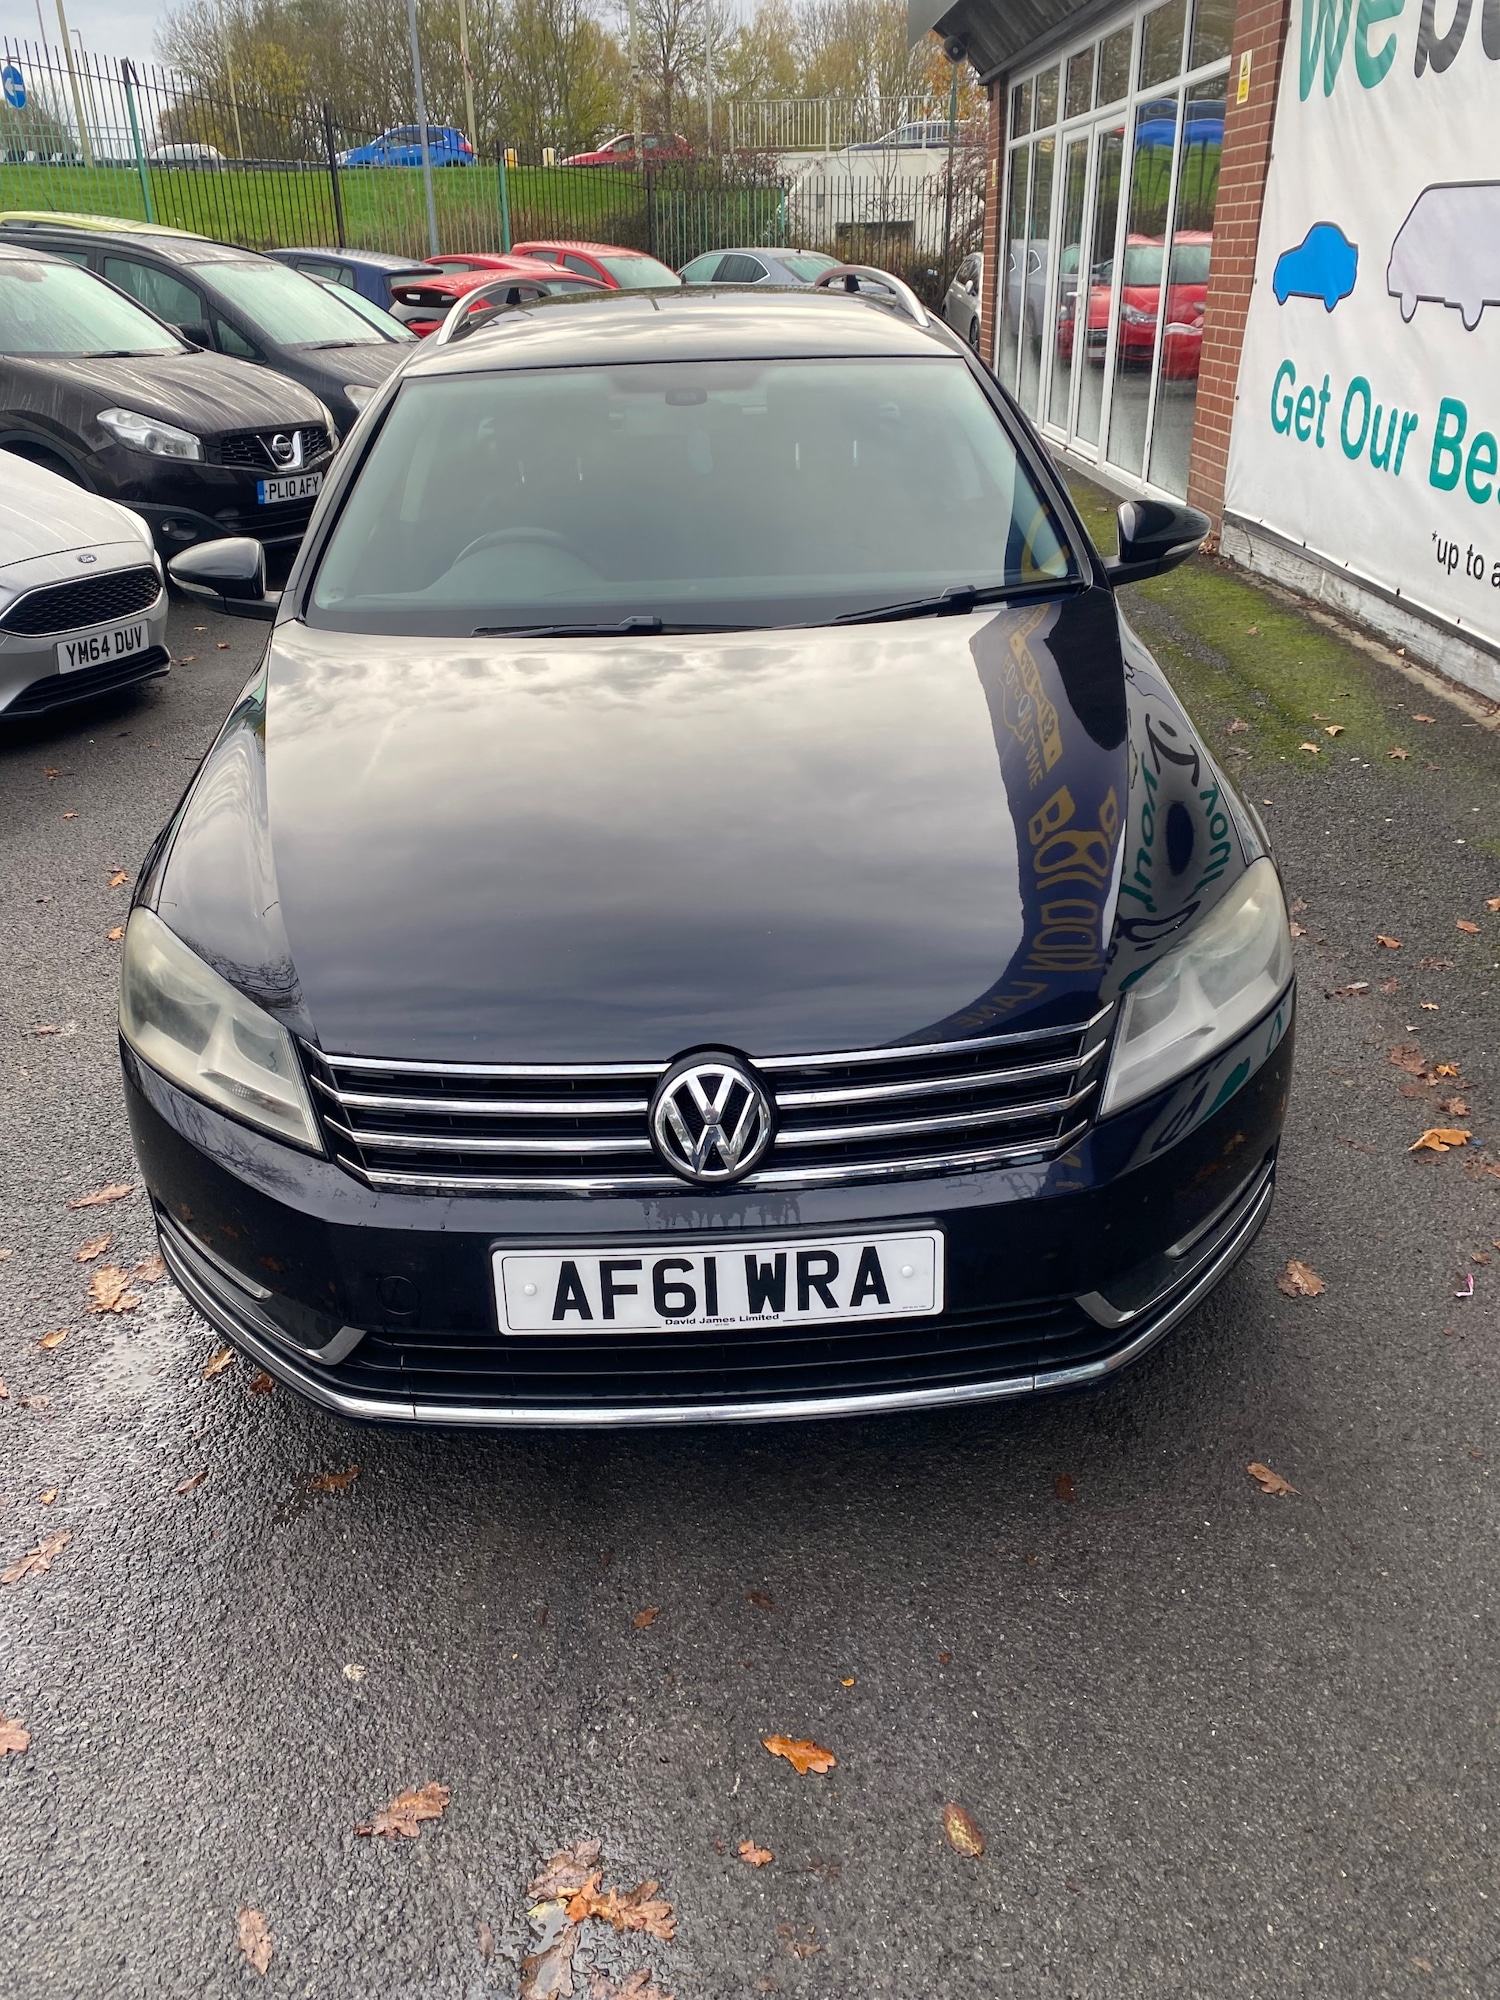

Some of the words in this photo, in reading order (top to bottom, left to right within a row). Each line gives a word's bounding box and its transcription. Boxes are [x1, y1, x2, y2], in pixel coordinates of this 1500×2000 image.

[1271, 359, 1331, 448] Get
[1341, 375, 1419, 476] Our
[1429, 397, 1500, 506] Be
[269, 480, 295, 499] PL10
[300, 476, 319, 495] AFY
[1466, 543, 1485, 580] to
[66, 635, 110, 666] YM64
[114, 626, 142, 654] DUV
[552, 1257, 719, 1321] AF61
[744, 1246, 891, 1314] WRA
[739, 1314, 779, 1322] Limited
